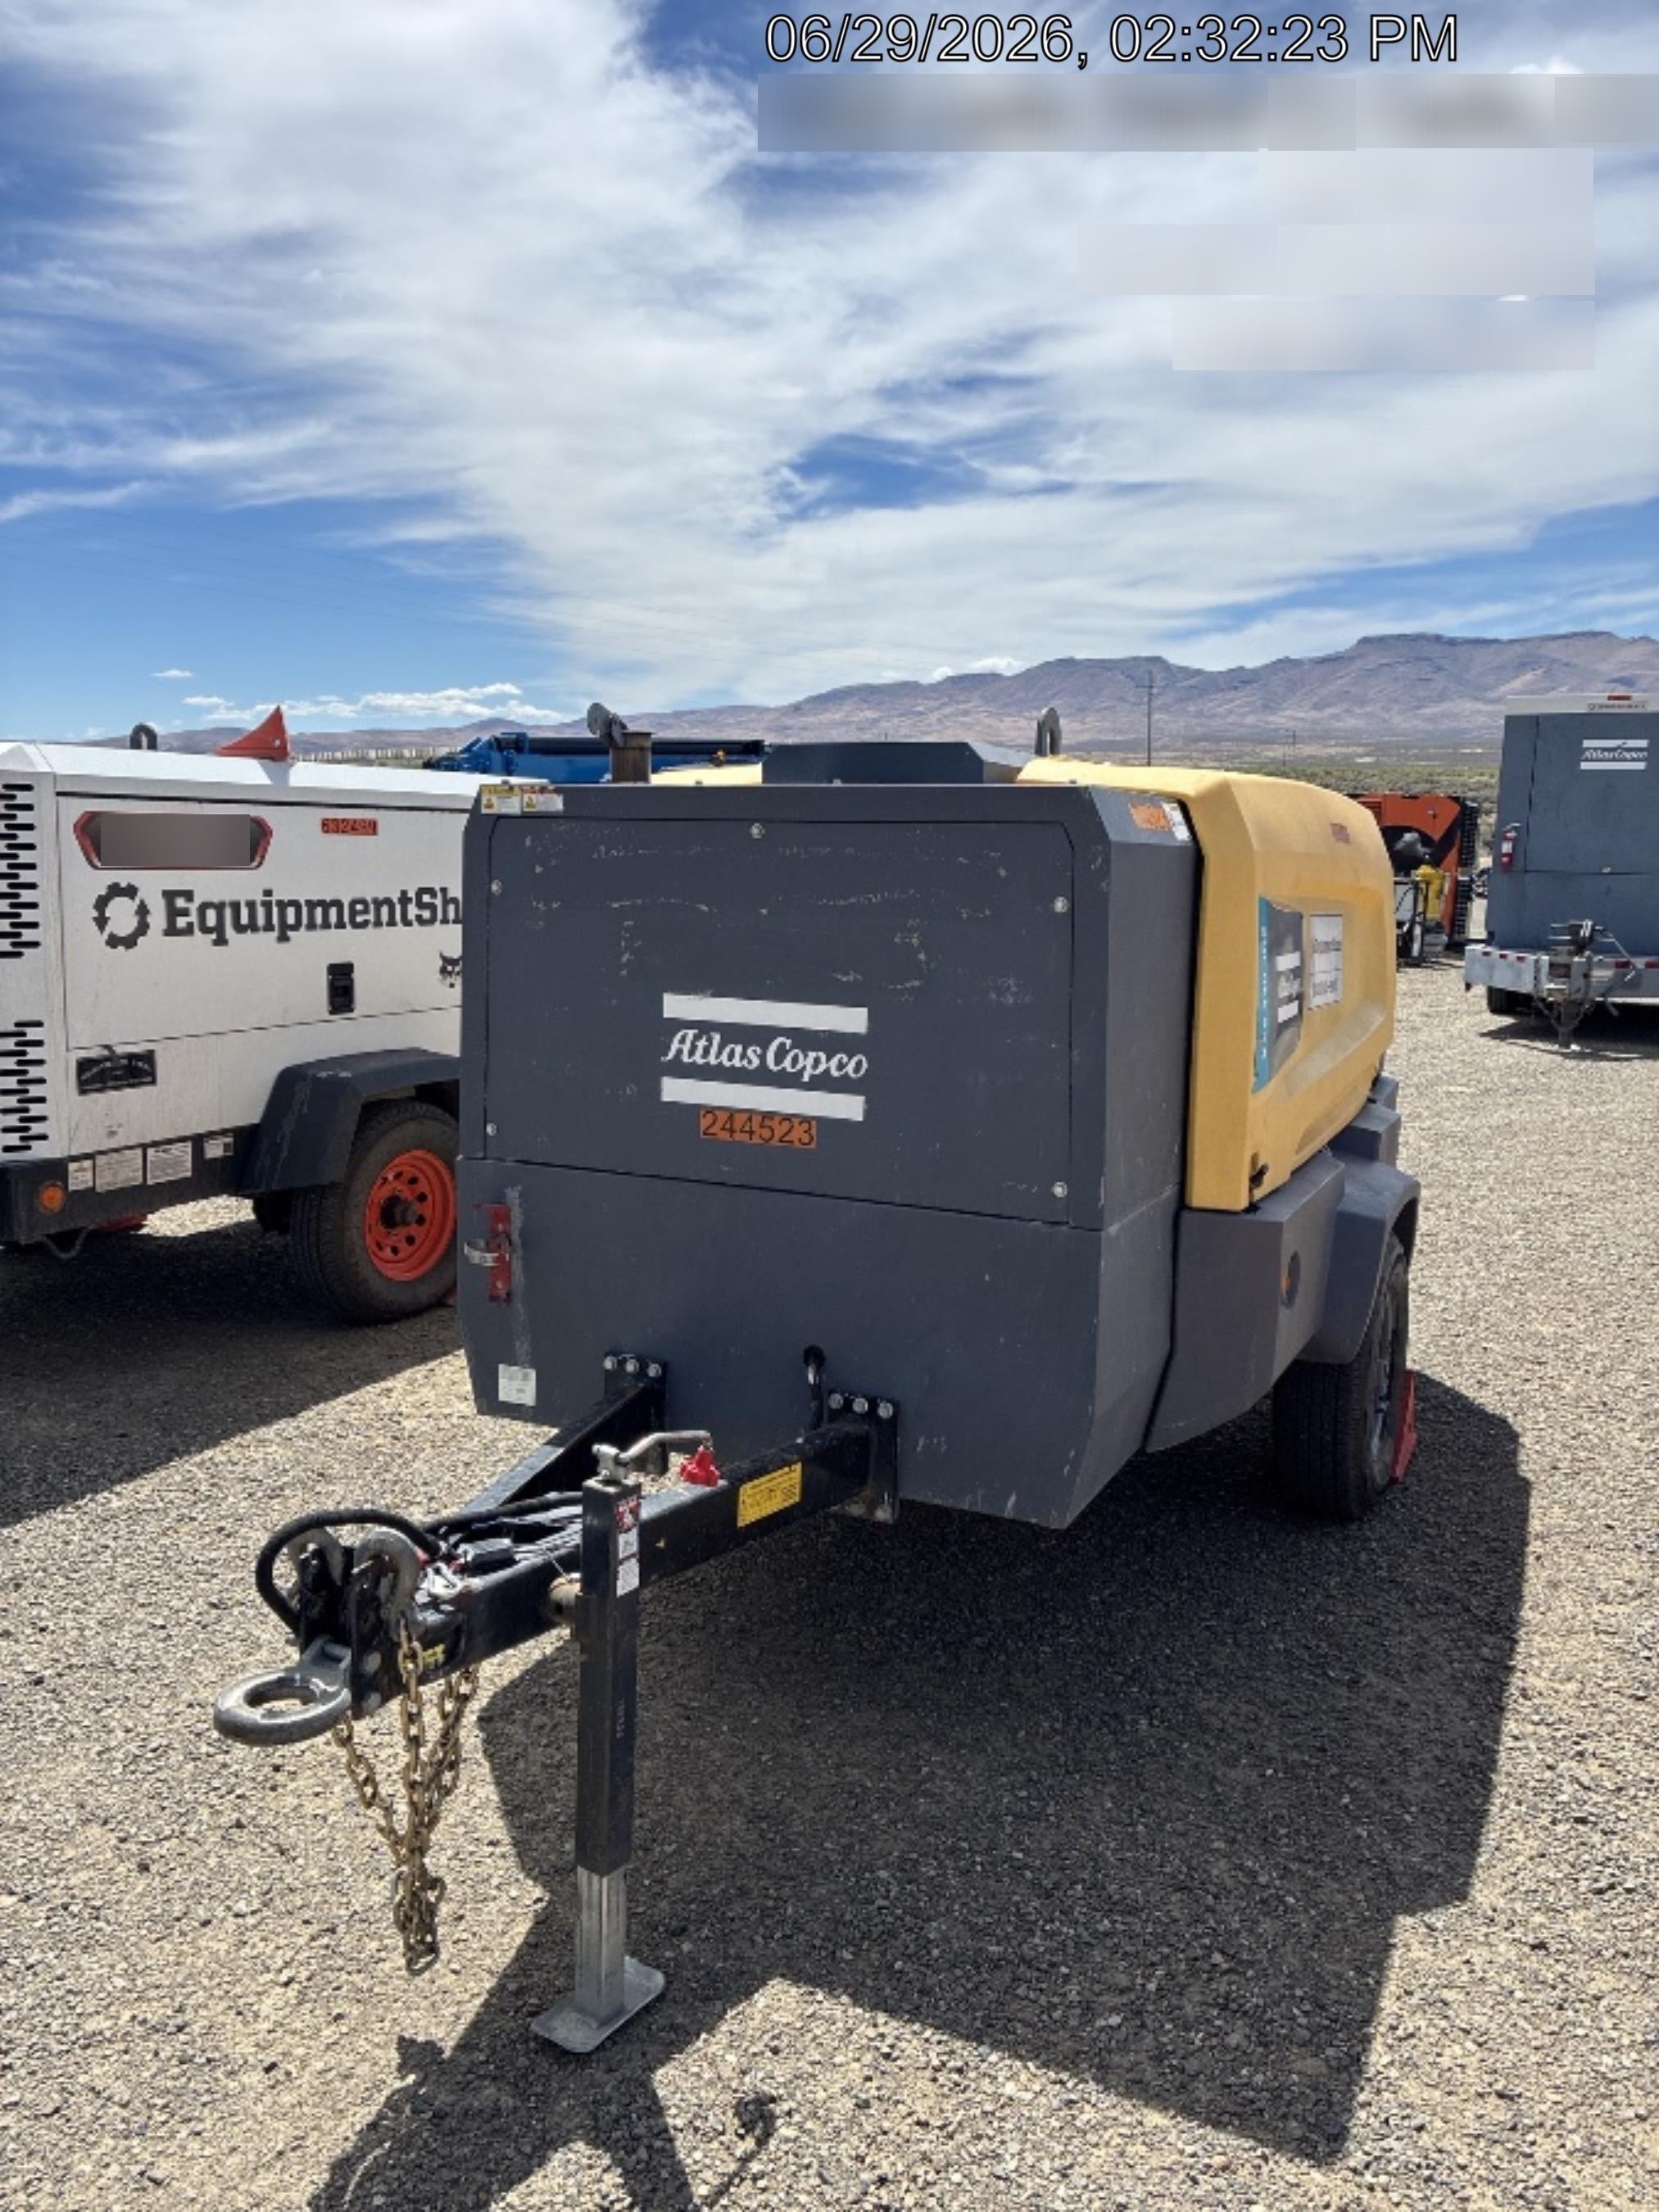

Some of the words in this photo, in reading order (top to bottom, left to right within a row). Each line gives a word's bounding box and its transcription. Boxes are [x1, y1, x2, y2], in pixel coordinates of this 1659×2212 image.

[660, 1029, 762, 1070] Atlas
[766, 1036, 868, 1082] Copco
[701, 1109, 814, 1146] 244523
